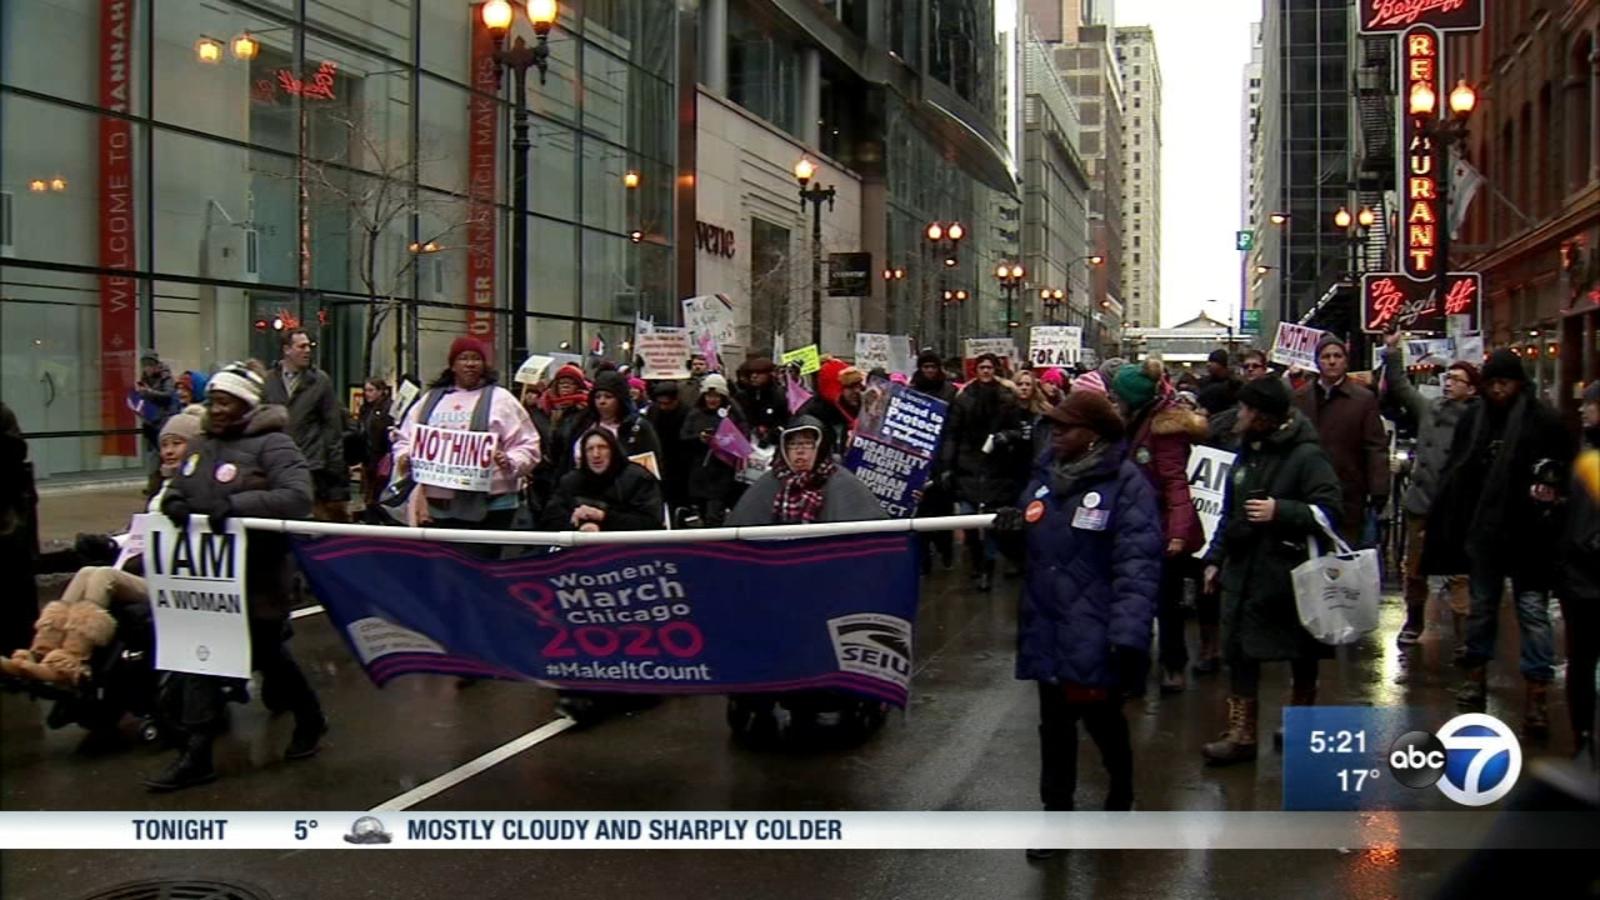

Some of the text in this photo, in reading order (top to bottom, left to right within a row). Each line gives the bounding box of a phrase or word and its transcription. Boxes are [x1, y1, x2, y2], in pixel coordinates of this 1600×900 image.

[108, 131, 127, 167] TO
[1408, 34, 1435, 270] REAURANT
[108, 171, 129, 312] WELCOME
[1371, 278, 1396, 297] The
[1368, 278, 1476, 328] Berghff
[1279, 324, 1320, 352] NOTHIN
[1031, 348, 1053, 364] FOR
[886, 407, 942, 434] Protect
[890, 396, 929, 419] United
[930, 411, 944, 423] to
[411, 427, 494, 468] NOTHING
[853, 436, 929, 469] DISABILITY
[862, 450, 912, 475] RIGHTS
[855, 466, 909, 492] HUMAN
[861, 478, 903, 501] GHTS
[151, 530, 163, 575] I
[169, 530, 236, 578] AM
[549, 560, 678, 588] Women's
[158, 589, 241, 614] A WOMAN
[554, 576, 685, 609] March
[566, 602, 691, 624] Chicago
[540, 620, 704, 658] 2020
[545, 660, 712, 681] #MakeItCount
[841, 646, 910, 677] SEIU
